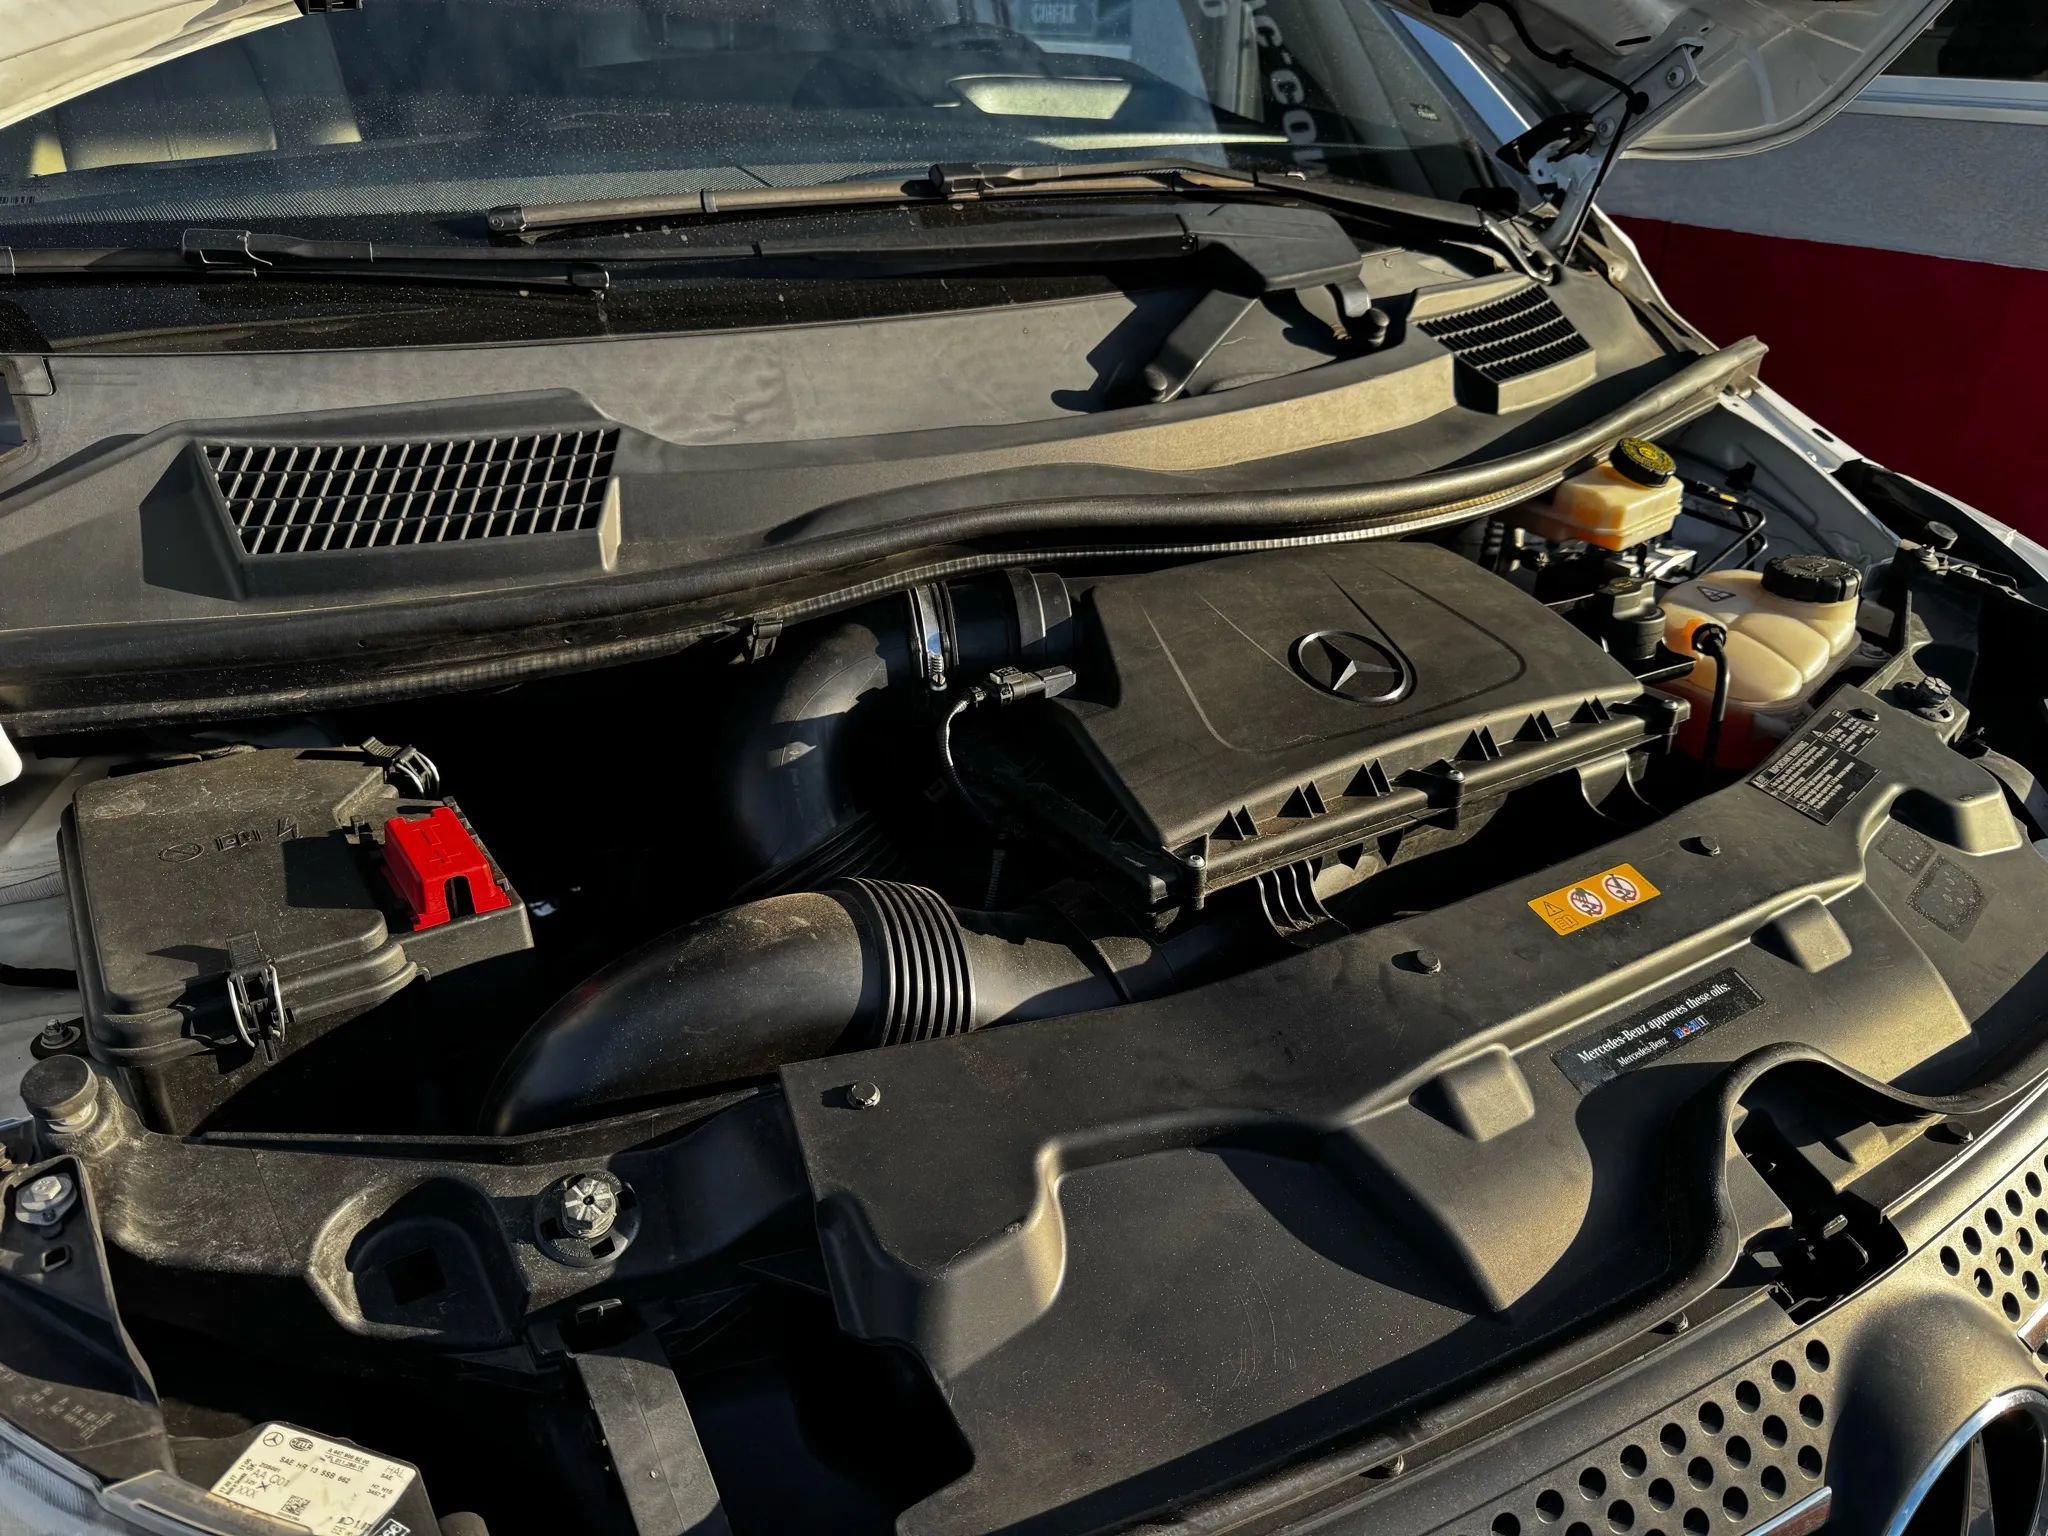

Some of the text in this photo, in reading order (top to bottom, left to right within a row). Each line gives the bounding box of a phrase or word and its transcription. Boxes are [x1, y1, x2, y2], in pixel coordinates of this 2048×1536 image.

[1577, 1024, 1649, 1064] Mercedes-Benz
[1647, 1004, 1688, 1029] approves
[1685, 992, 1712, 1009] these
[1710, 983, 1731, 997] oils:
[1672, 1018, 1700, 1039] Mobil
[1616, 1037, 1669, 1067] Mercedes-Benz
